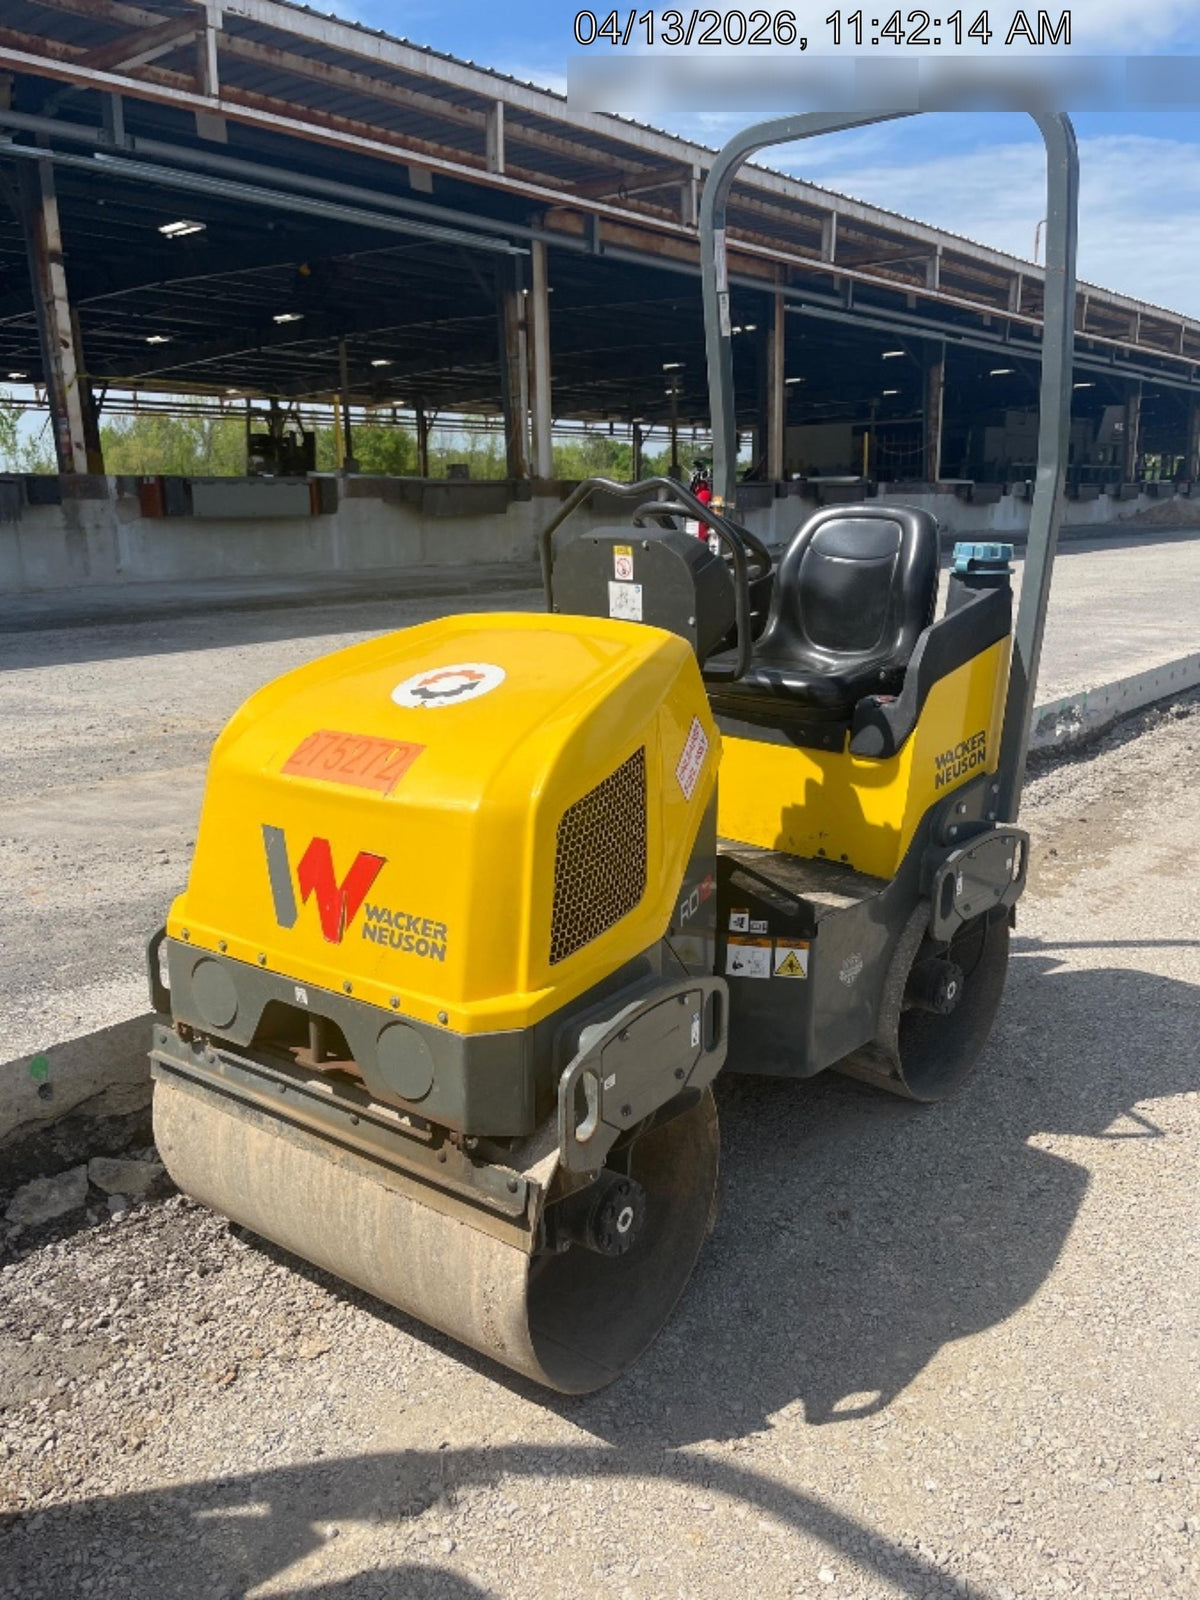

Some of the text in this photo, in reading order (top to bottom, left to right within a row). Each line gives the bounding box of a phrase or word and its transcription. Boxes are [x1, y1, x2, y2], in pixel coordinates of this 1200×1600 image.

[934, 729, 986, 770] WACKER
[934, 746, 986, 790] NEUSON
[361, 922, 447, 962] NEUSON
[363, 902, 448, 943] WACKER
